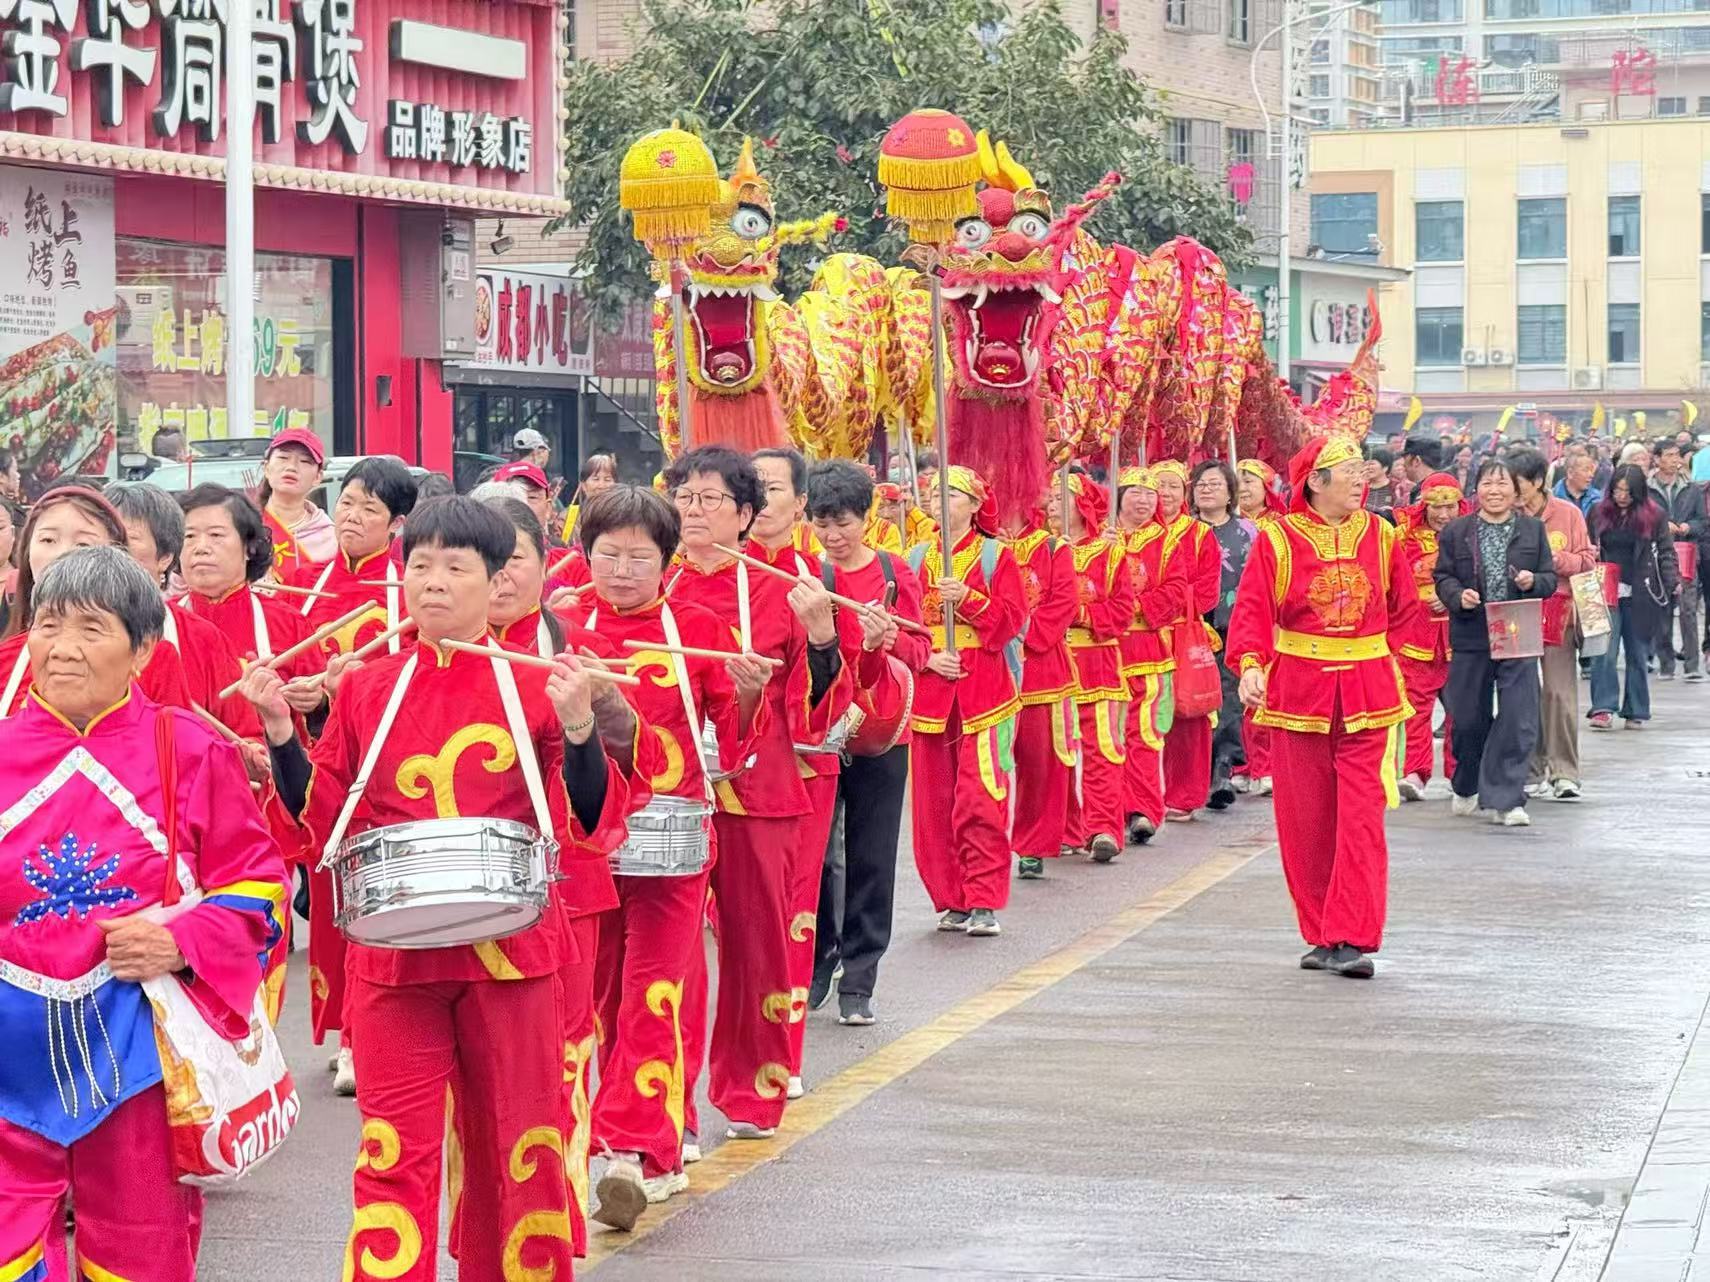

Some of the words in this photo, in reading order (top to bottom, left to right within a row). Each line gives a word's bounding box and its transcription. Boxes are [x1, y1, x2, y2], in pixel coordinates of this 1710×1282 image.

[388, 100, 532, 173] 品牌形象店
[496, 276, 568, 367] 成都小吃
